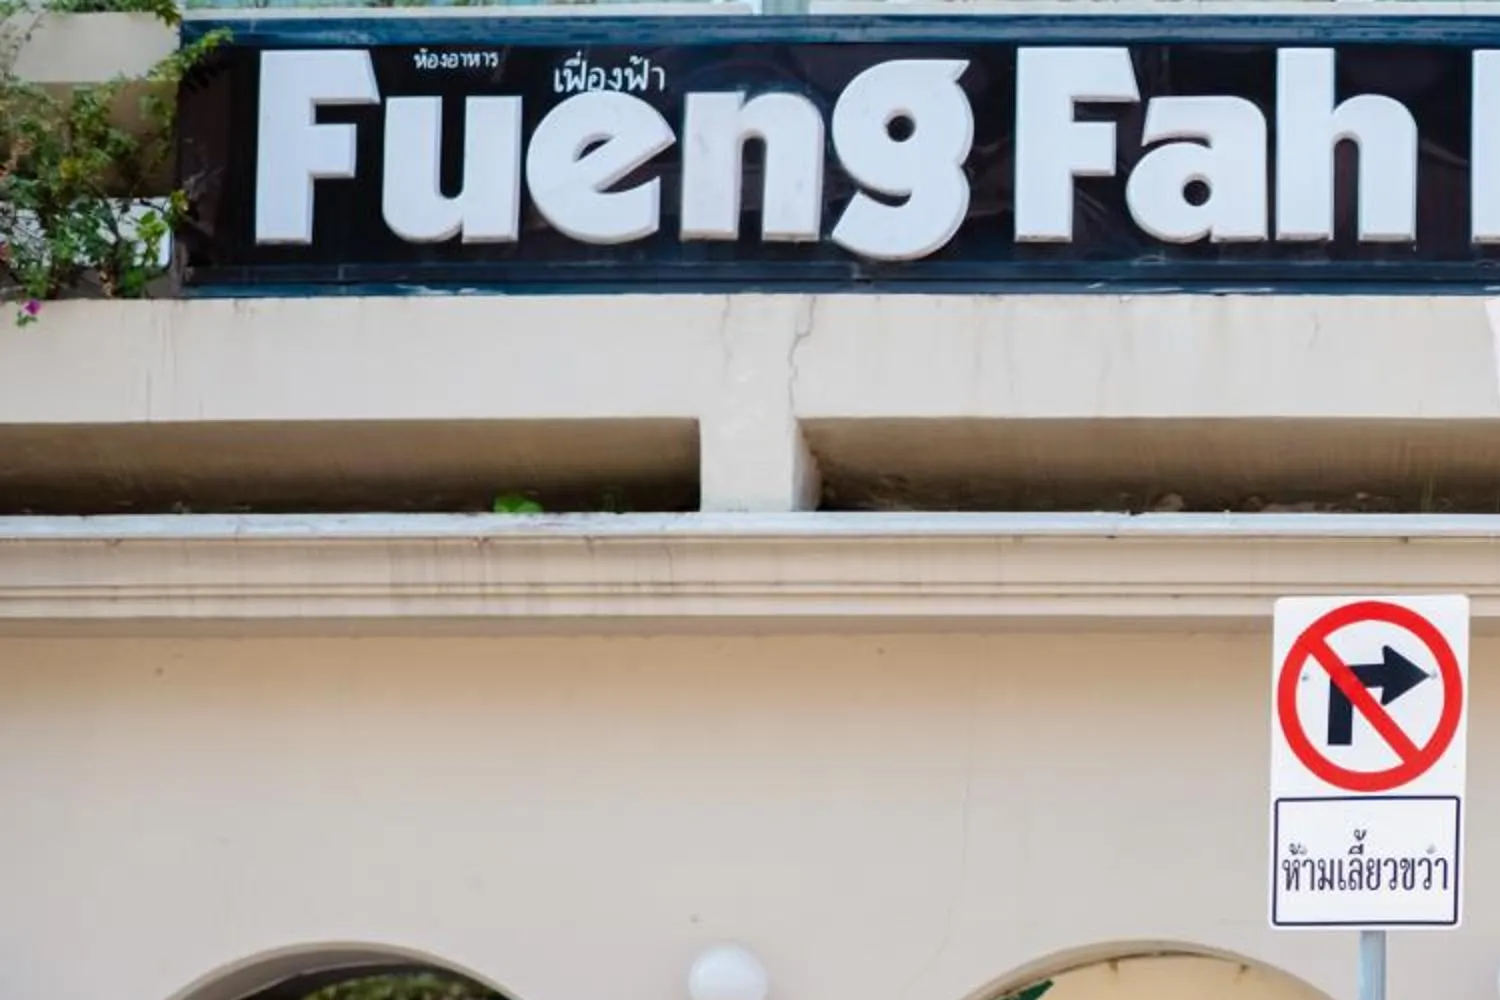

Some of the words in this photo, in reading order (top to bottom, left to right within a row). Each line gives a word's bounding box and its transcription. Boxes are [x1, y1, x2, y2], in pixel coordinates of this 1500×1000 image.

[413, 48, 500, 69] ห้องอาหาร
[553, 51, 666, 93] เฟื่องฟ้า
[254, 48, 975, 260] Fueng
[1013, 45, 1418, 243] Fah
[1282, 828, 1450, 891] ห้ามเลี้ยวขวา
